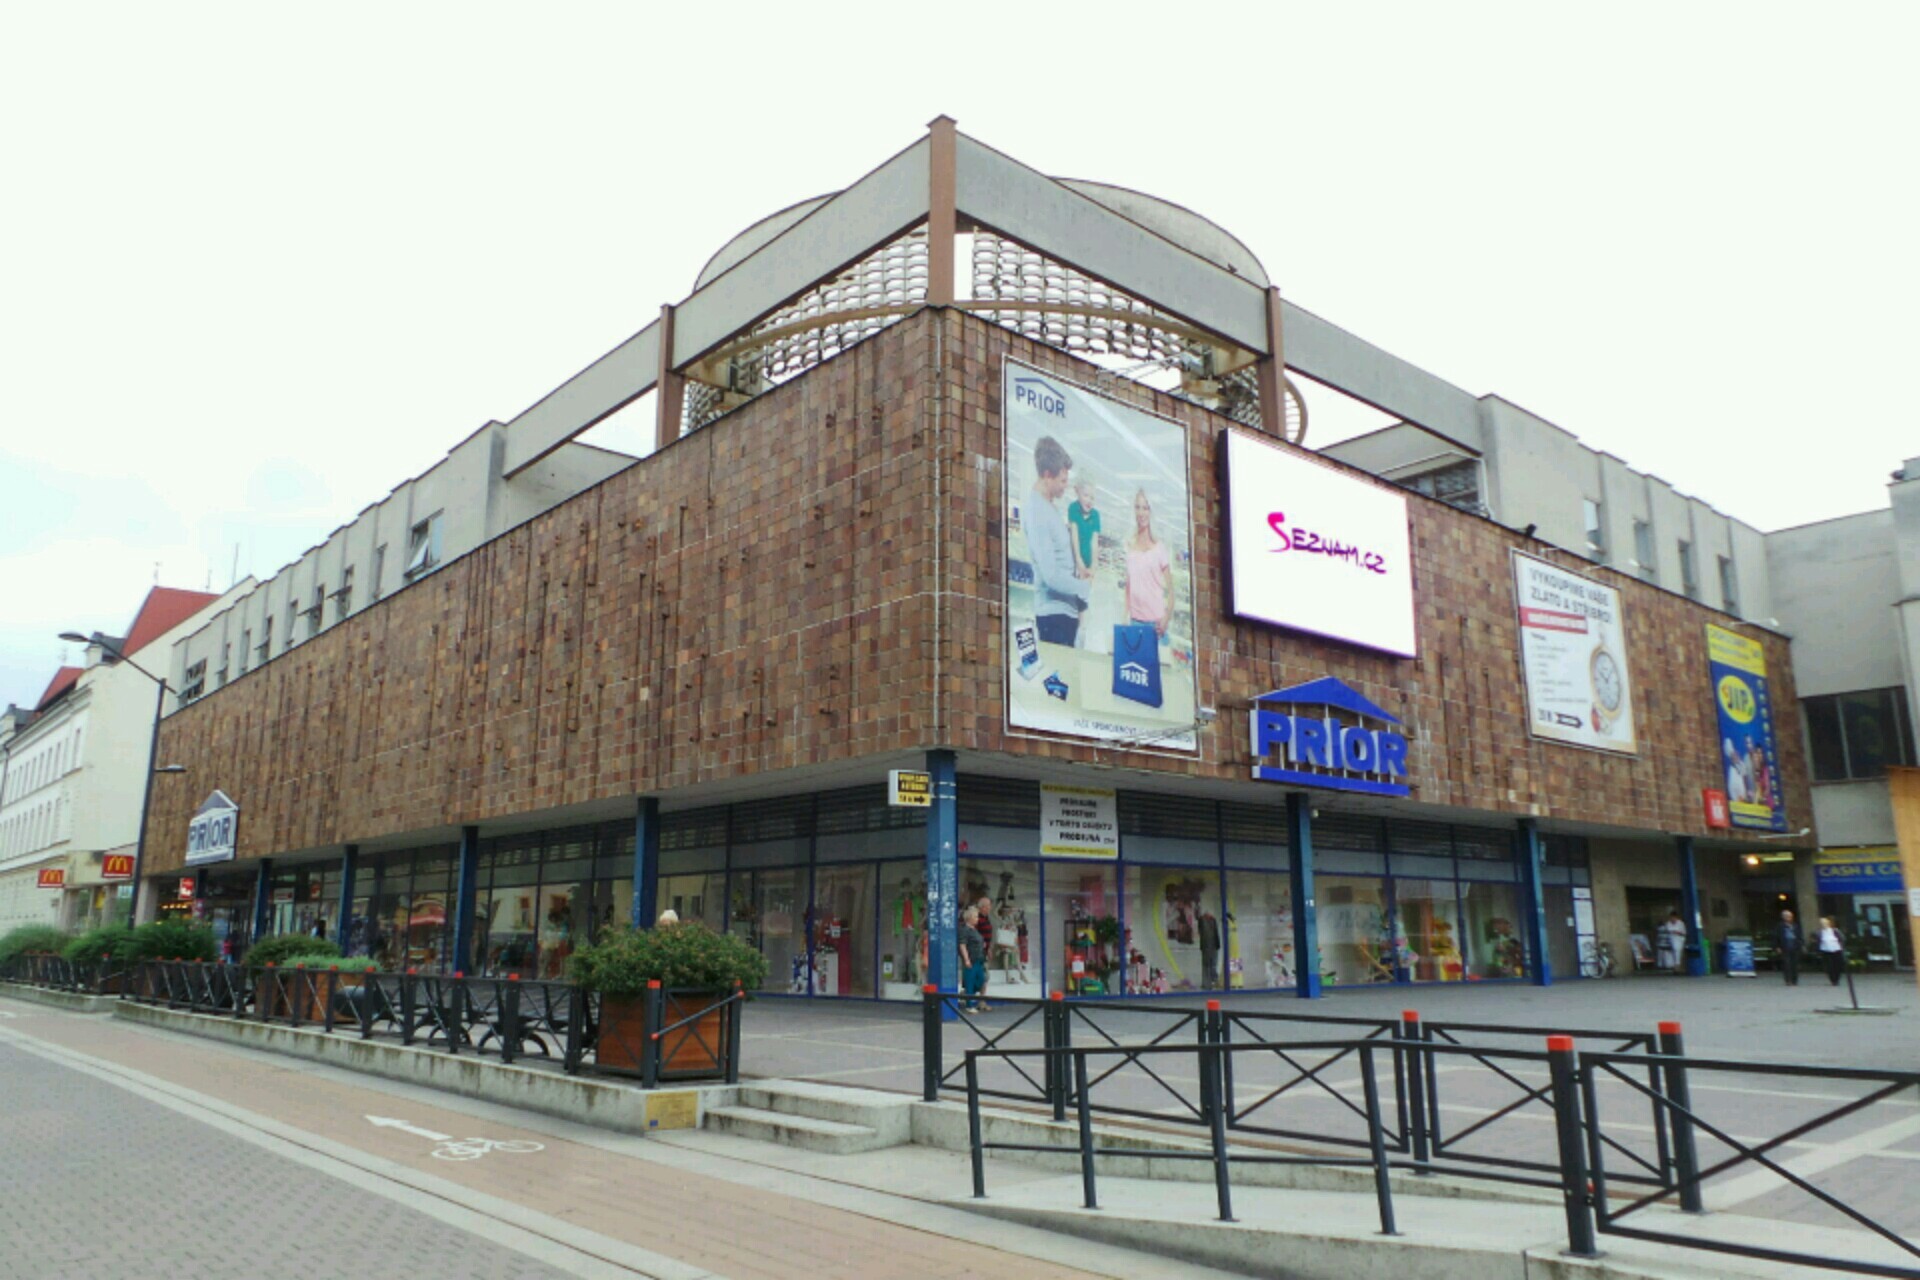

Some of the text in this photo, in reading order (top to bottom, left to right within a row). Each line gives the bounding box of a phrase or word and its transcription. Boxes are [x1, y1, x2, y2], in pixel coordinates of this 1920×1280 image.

[1015, 384, 1066, 418] PRIOR
[1120, 669, 1149, 687] PRIOR
[1250, 709, 1409, 777] PRIOR
[189, 816, 231, 851] PRIOR
